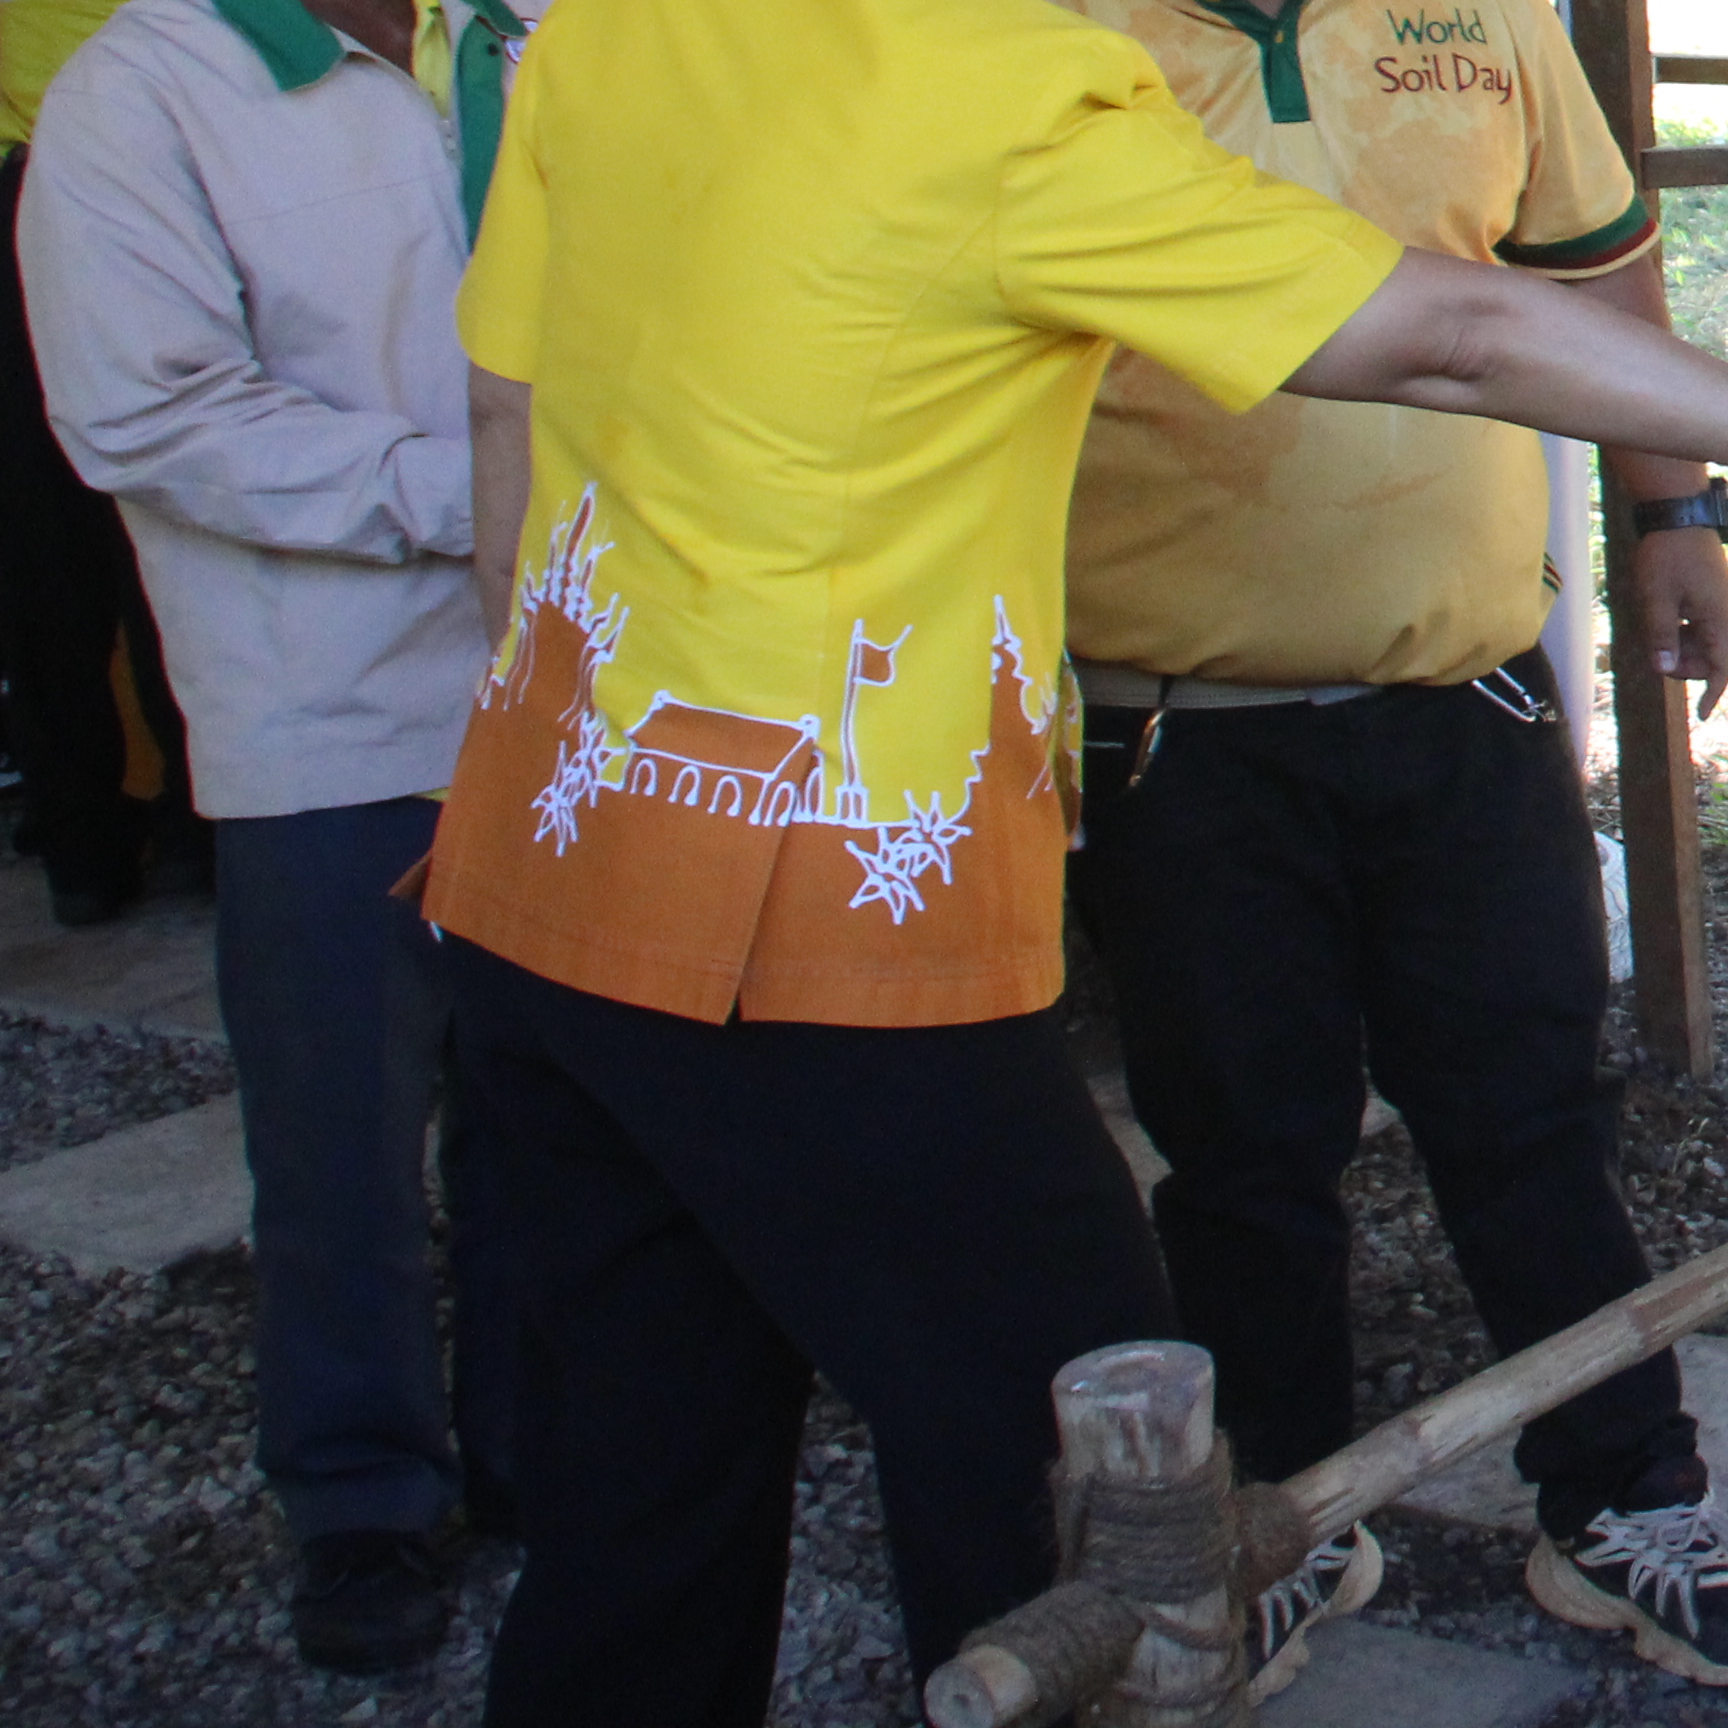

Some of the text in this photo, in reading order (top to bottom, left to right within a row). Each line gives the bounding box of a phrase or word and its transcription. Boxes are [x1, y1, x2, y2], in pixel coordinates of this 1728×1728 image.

[1386, 7, 1488, 45] World
[1374, 52, 1513, 106] Soil Day
